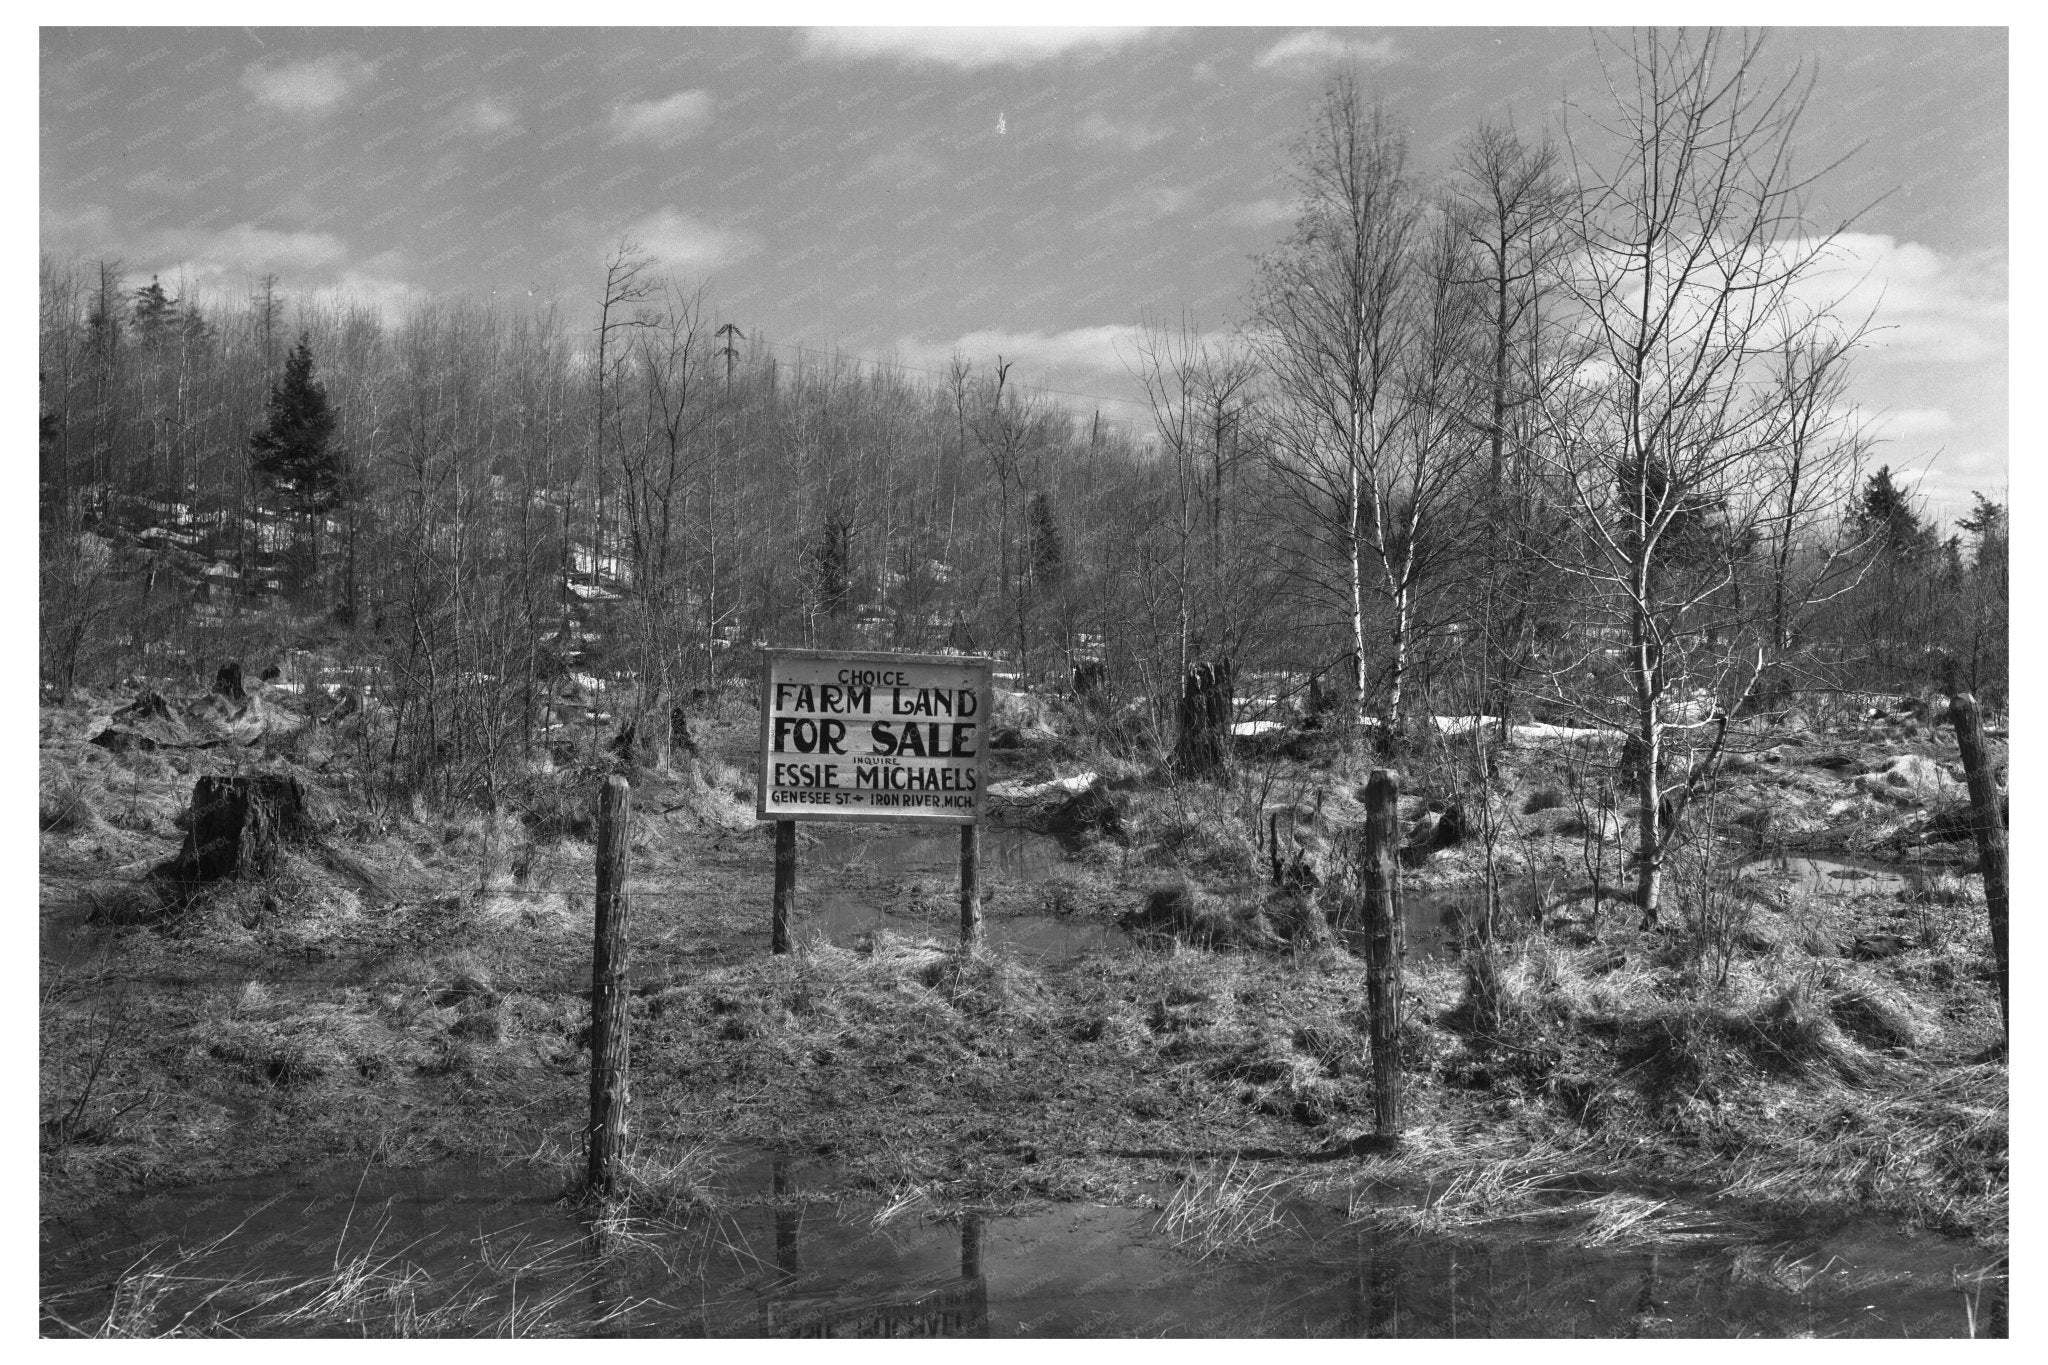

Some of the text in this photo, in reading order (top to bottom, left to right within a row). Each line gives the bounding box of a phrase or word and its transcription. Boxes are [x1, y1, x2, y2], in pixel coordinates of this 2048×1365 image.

[838, 668, 909, 687] CHOICE
[776, 683, 978, 717] FARM LAND
[774, 717, 977, 758] FOR SALE
[853, 756, 901, 766] INQUIRE
[775, 763, 977, 791] ESSIE MICHAELS
[771, 790, 831, 804] GENESEE
[870, 793, 899, 806] IRON
